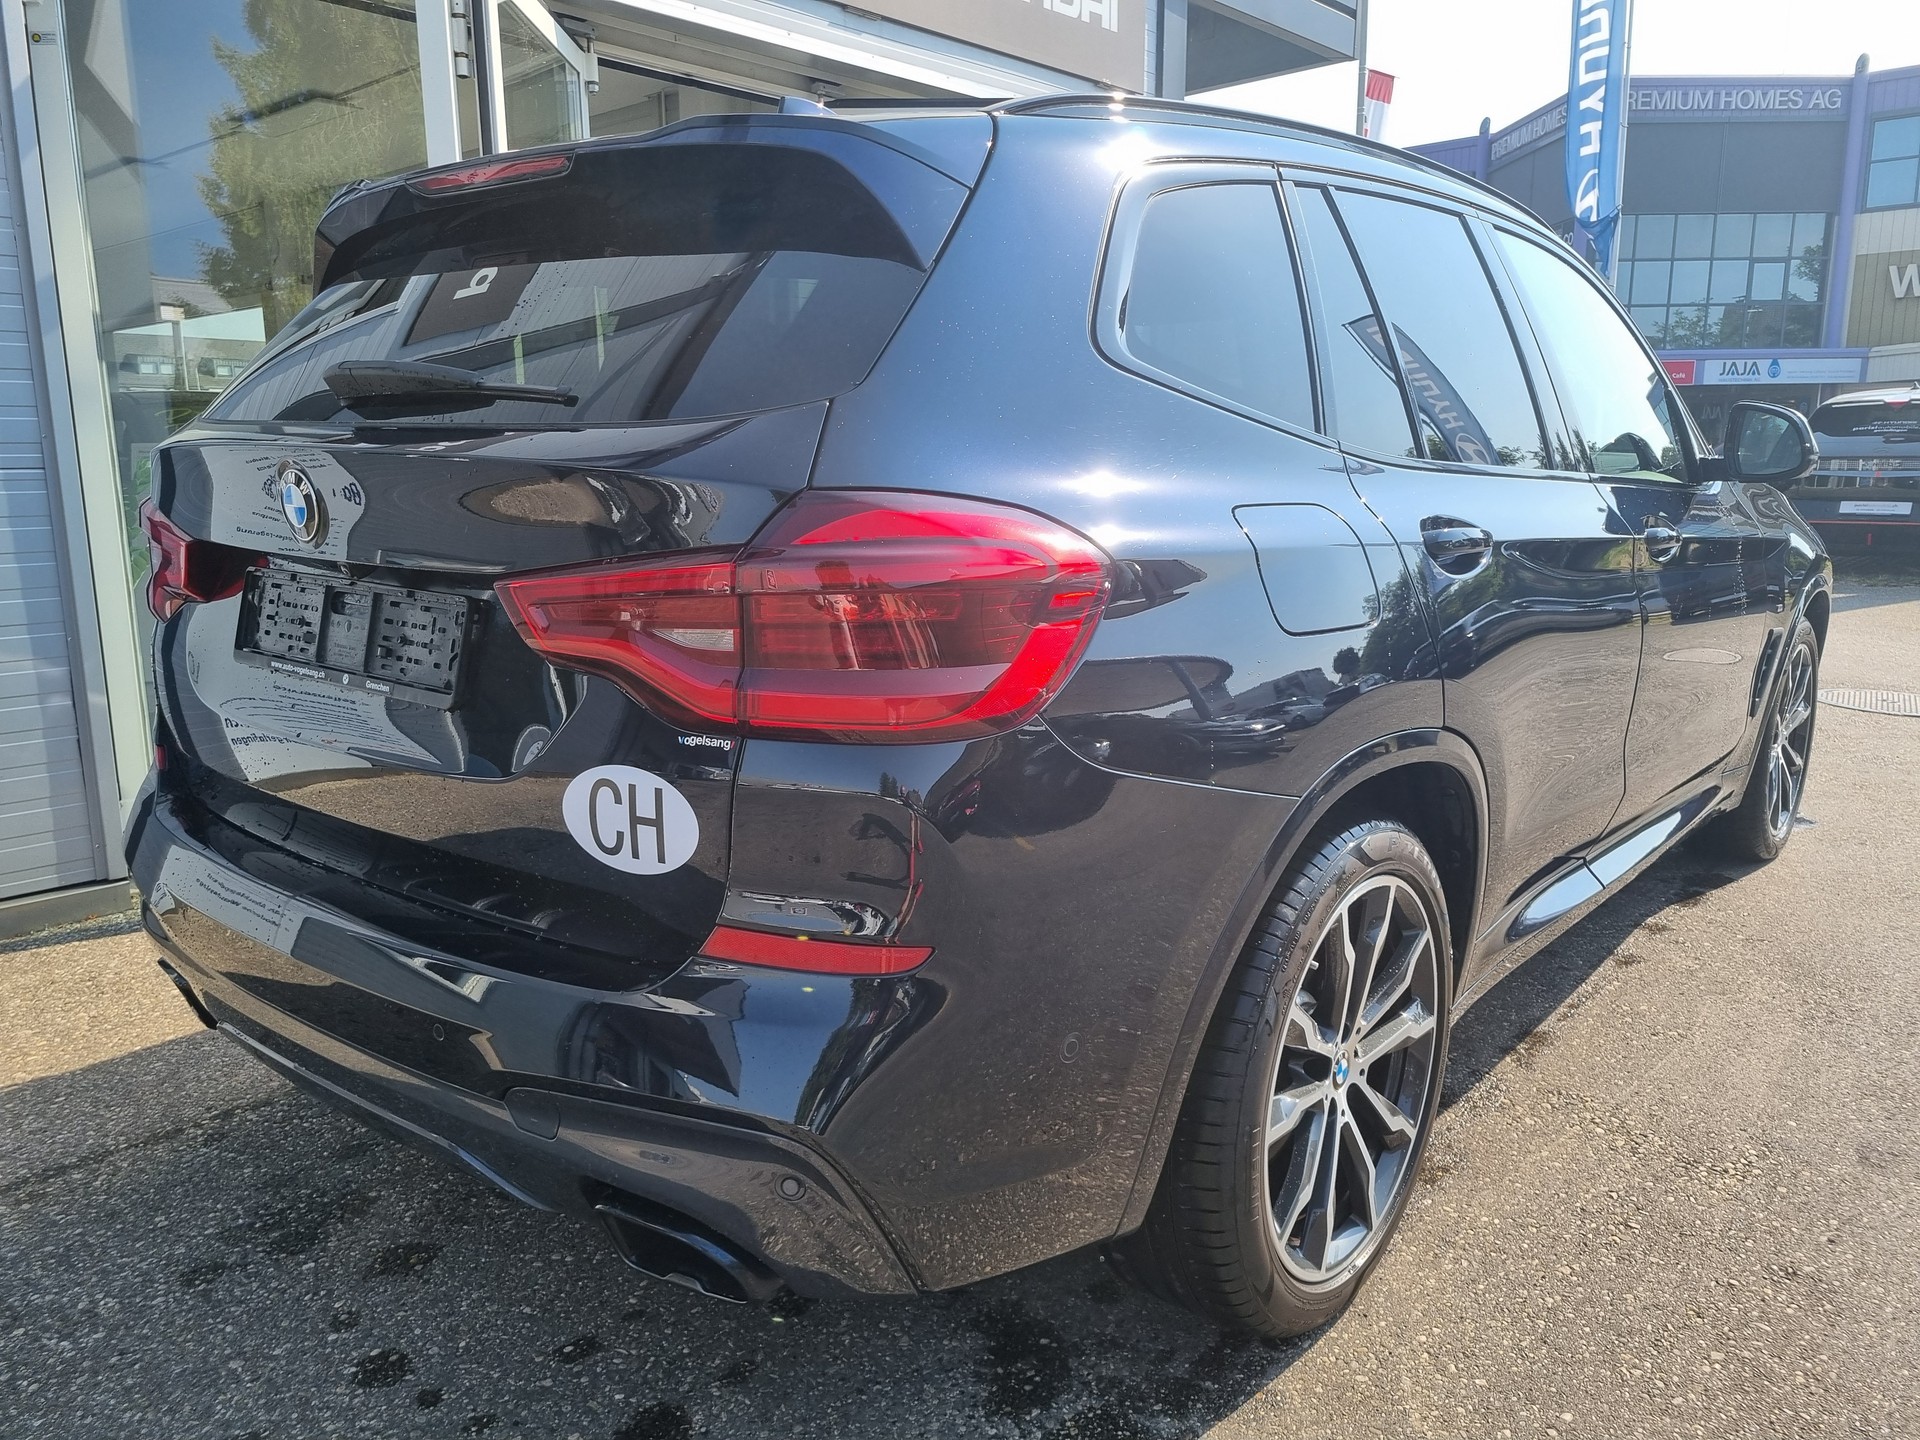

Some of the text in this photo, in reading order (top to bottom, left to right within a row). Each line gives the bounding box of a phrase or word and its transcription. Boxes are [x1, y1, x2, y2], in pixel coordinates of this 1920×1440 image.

[1628, 88, 1842, 110] REMIUM HOMES AG
[1491, 124, 1532, 161] PREMIUM
[1719, 361, 1761, 377] JAJA
[270, 660, 390, 693] www.auto-vogelsang.ch Grenchen
[588, 777, 666, 865] CH
